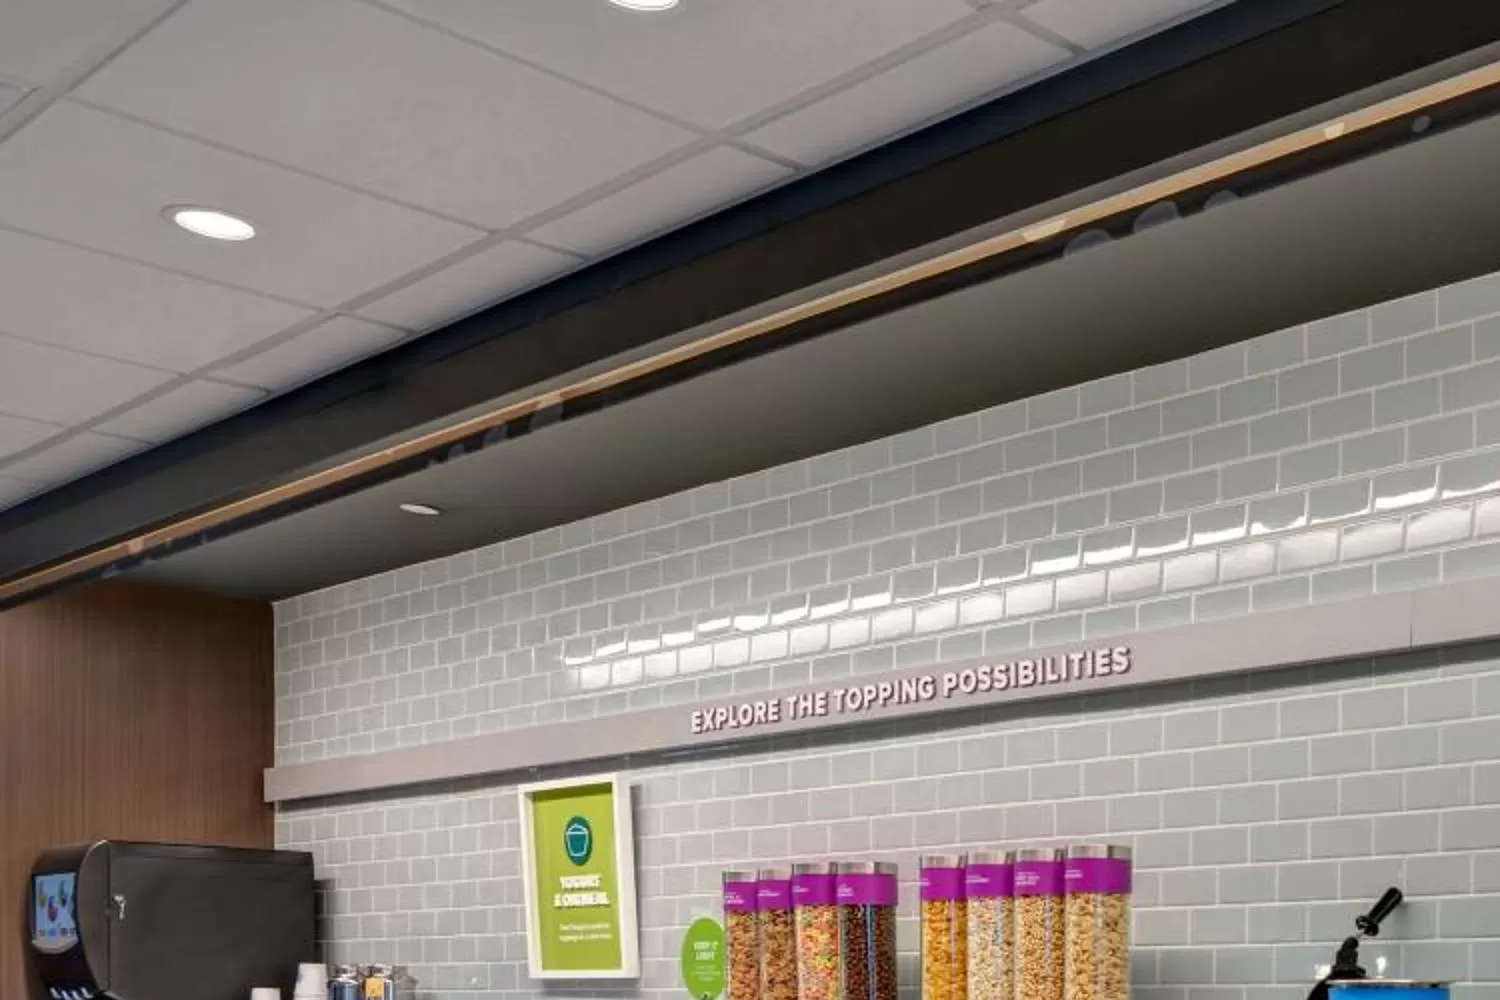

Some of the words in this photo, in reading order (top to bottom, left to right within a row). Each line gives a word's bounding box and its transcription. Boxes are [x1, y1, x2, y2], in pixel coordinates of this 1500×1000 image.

[690, 698, 781, 734] EXPLORE
[787, 690, 829, 720] THE
[834, 674, 937, 712] TOPPING
[944, 646, 1132, 698] POSSIBILITIES
